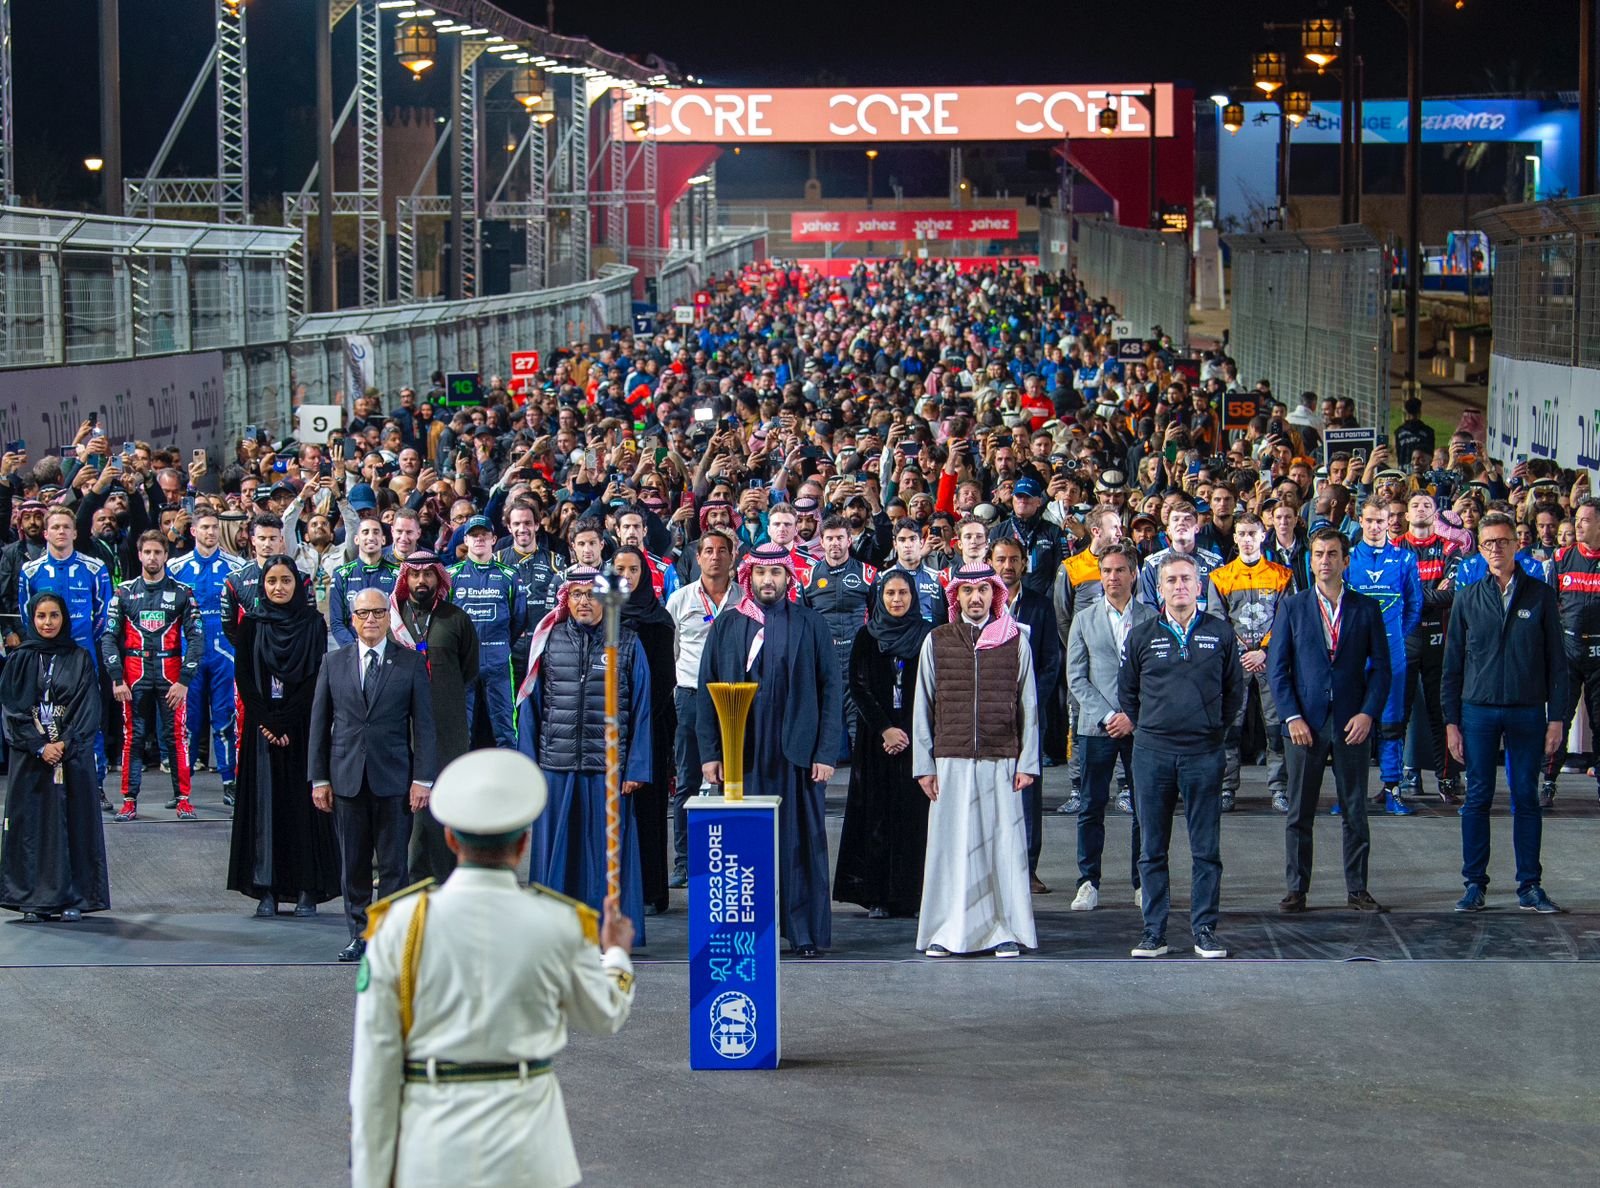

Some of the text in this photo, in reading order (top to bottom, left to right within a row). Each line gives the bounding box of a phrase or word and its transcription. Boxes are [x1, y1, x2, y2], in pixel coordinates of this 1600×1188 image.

[648, 94, 772, 136] CORE
[829, 93, 958, 135] CORE
[1015, 91, 1145, 133] CORE
[638, 321, 647, 331] 7
[1115, 326, 1128, 335] 10
[1121, 343, 1140, 354] 48
[515, 357, 535, 369] 27
[1228, 402, 1256, 417] 58
[312, 416, 328, 432] 9
[468, 587, 500, 595] Envision
[1430, 634, 1443, 645] 27
[709, 824, 723, 923] 2023 CORE
[725, 854, 739, 923] DIRIYAH
[741, 866, 755, 923] E-PRIX
